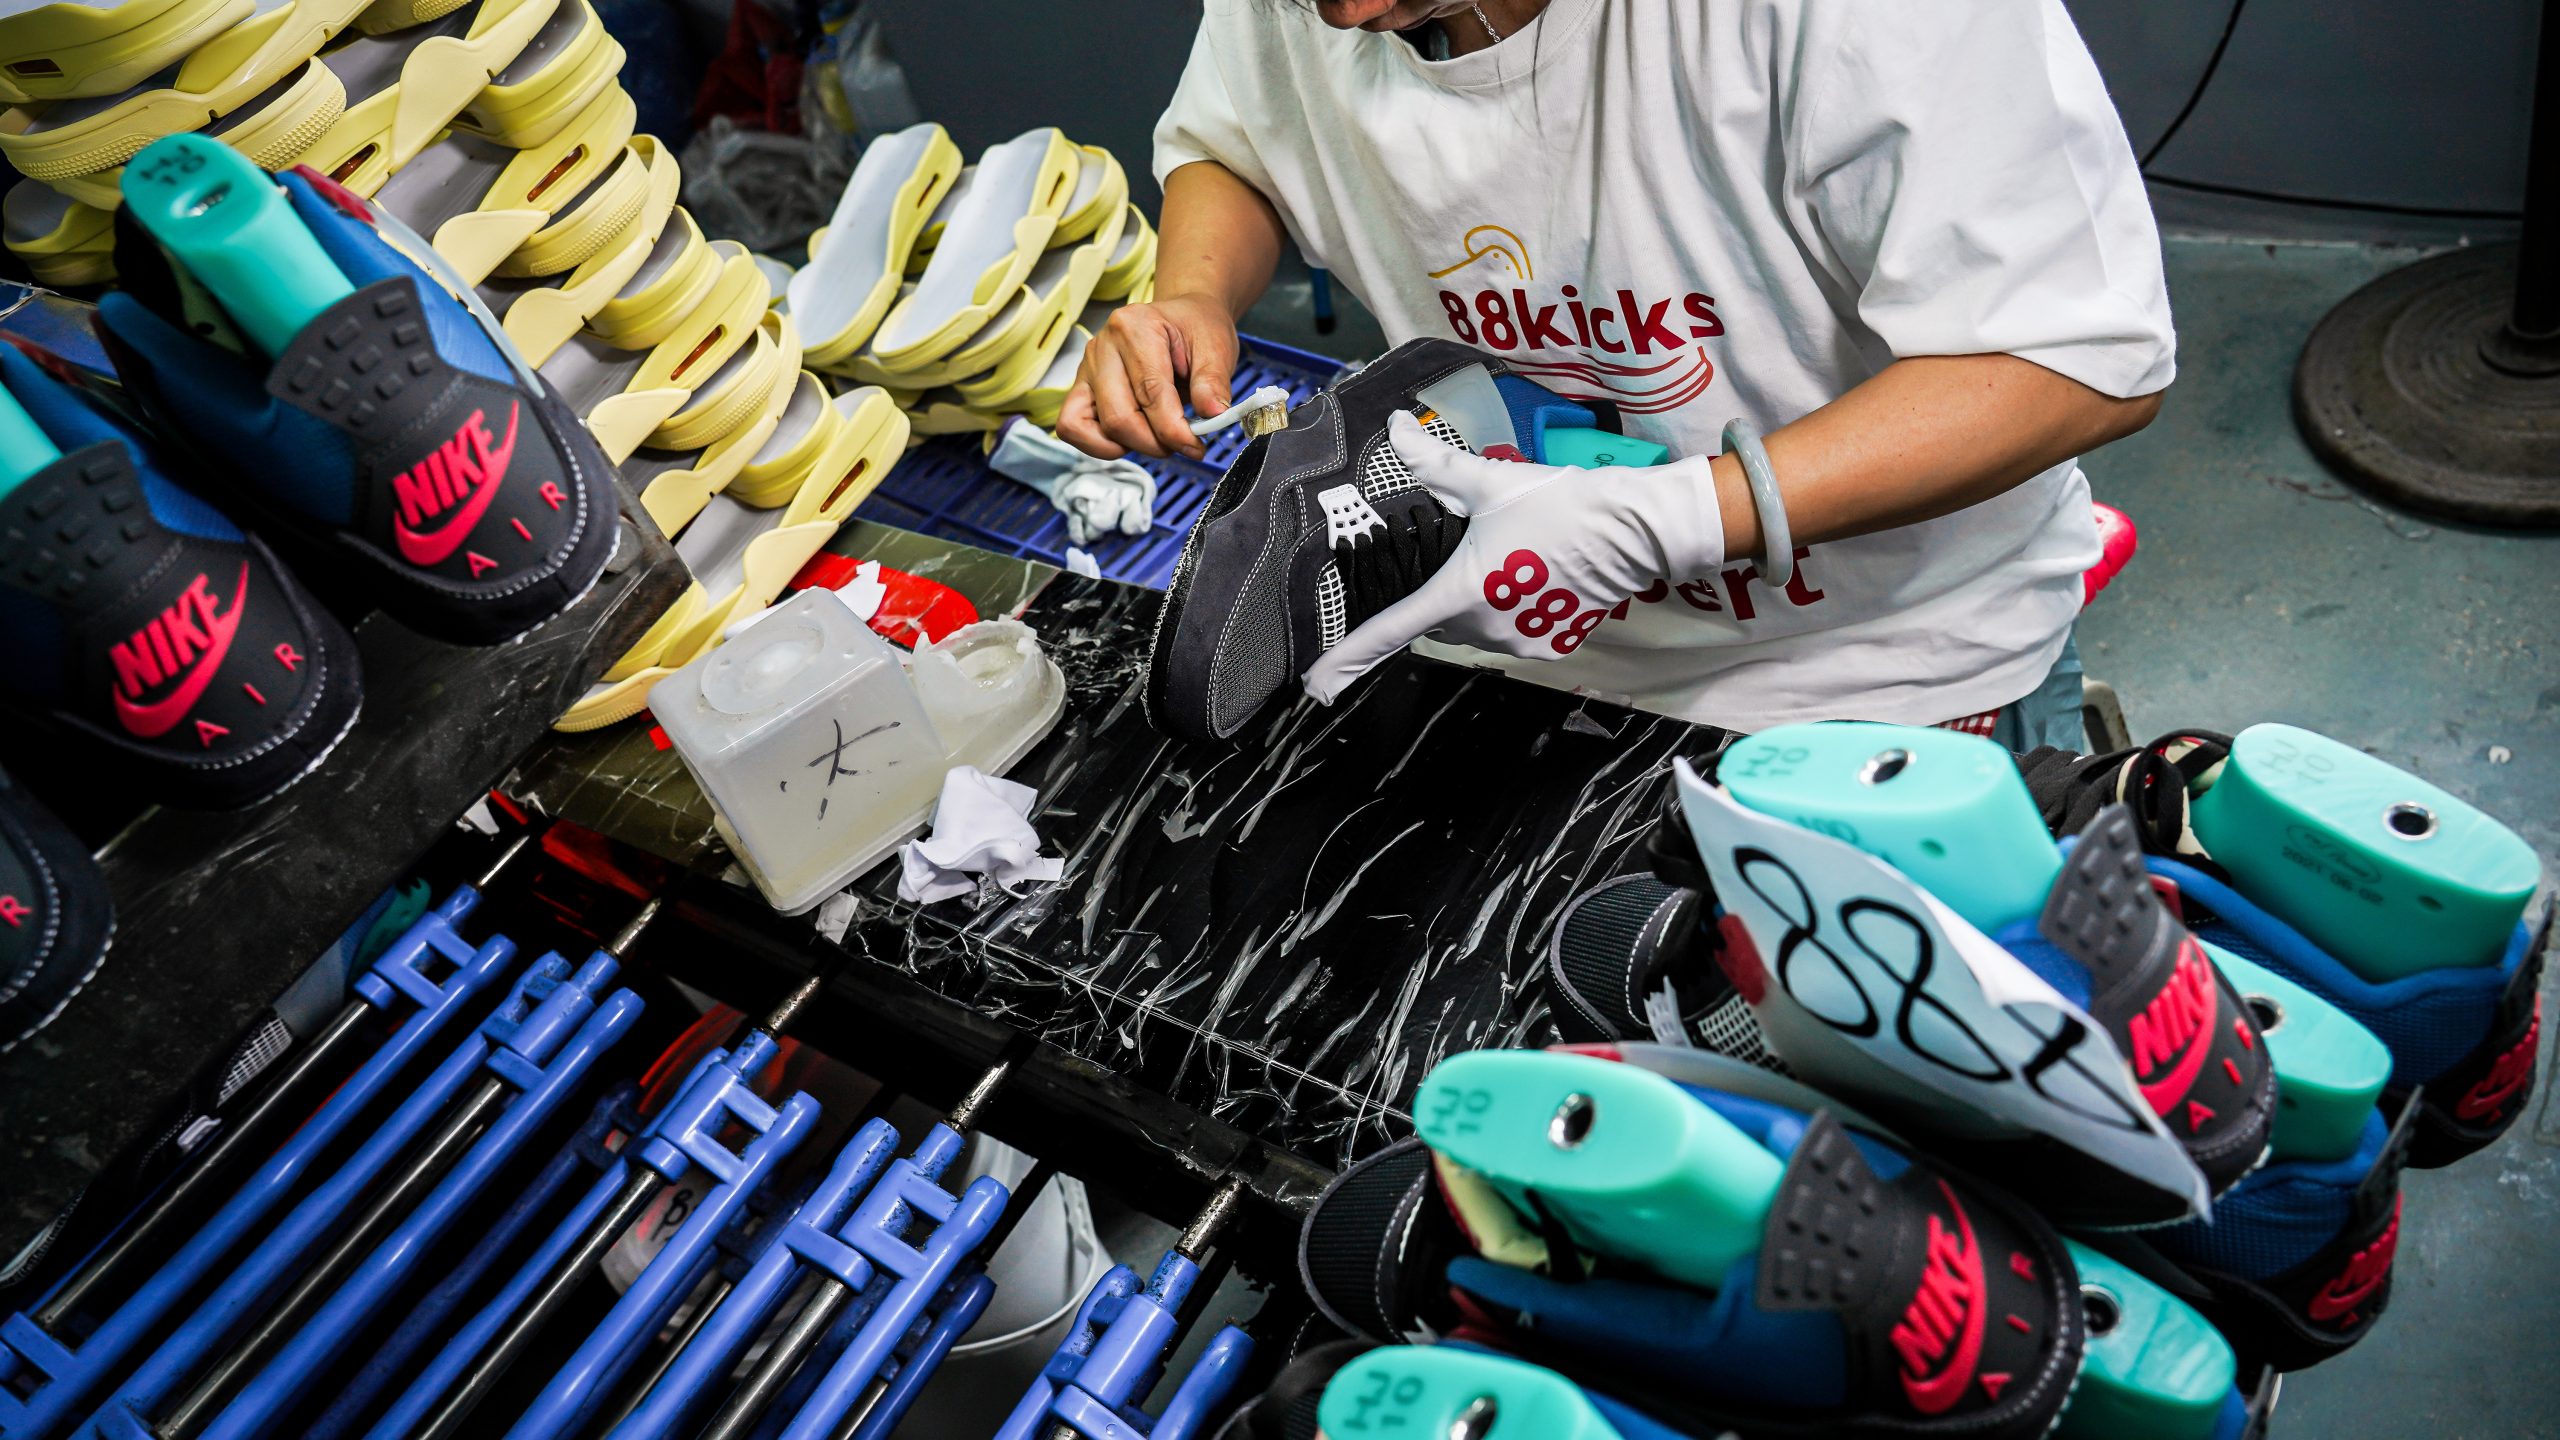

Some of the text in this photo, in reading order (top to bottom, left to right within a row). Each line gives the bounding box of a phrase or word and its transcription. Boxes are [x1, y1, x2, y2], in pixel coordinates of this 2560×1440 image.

[1438, 284, 1725, 355] 88kicks
[392, 408, 498, 528] NIKE
[109, 573, 235, 698] NIKE
